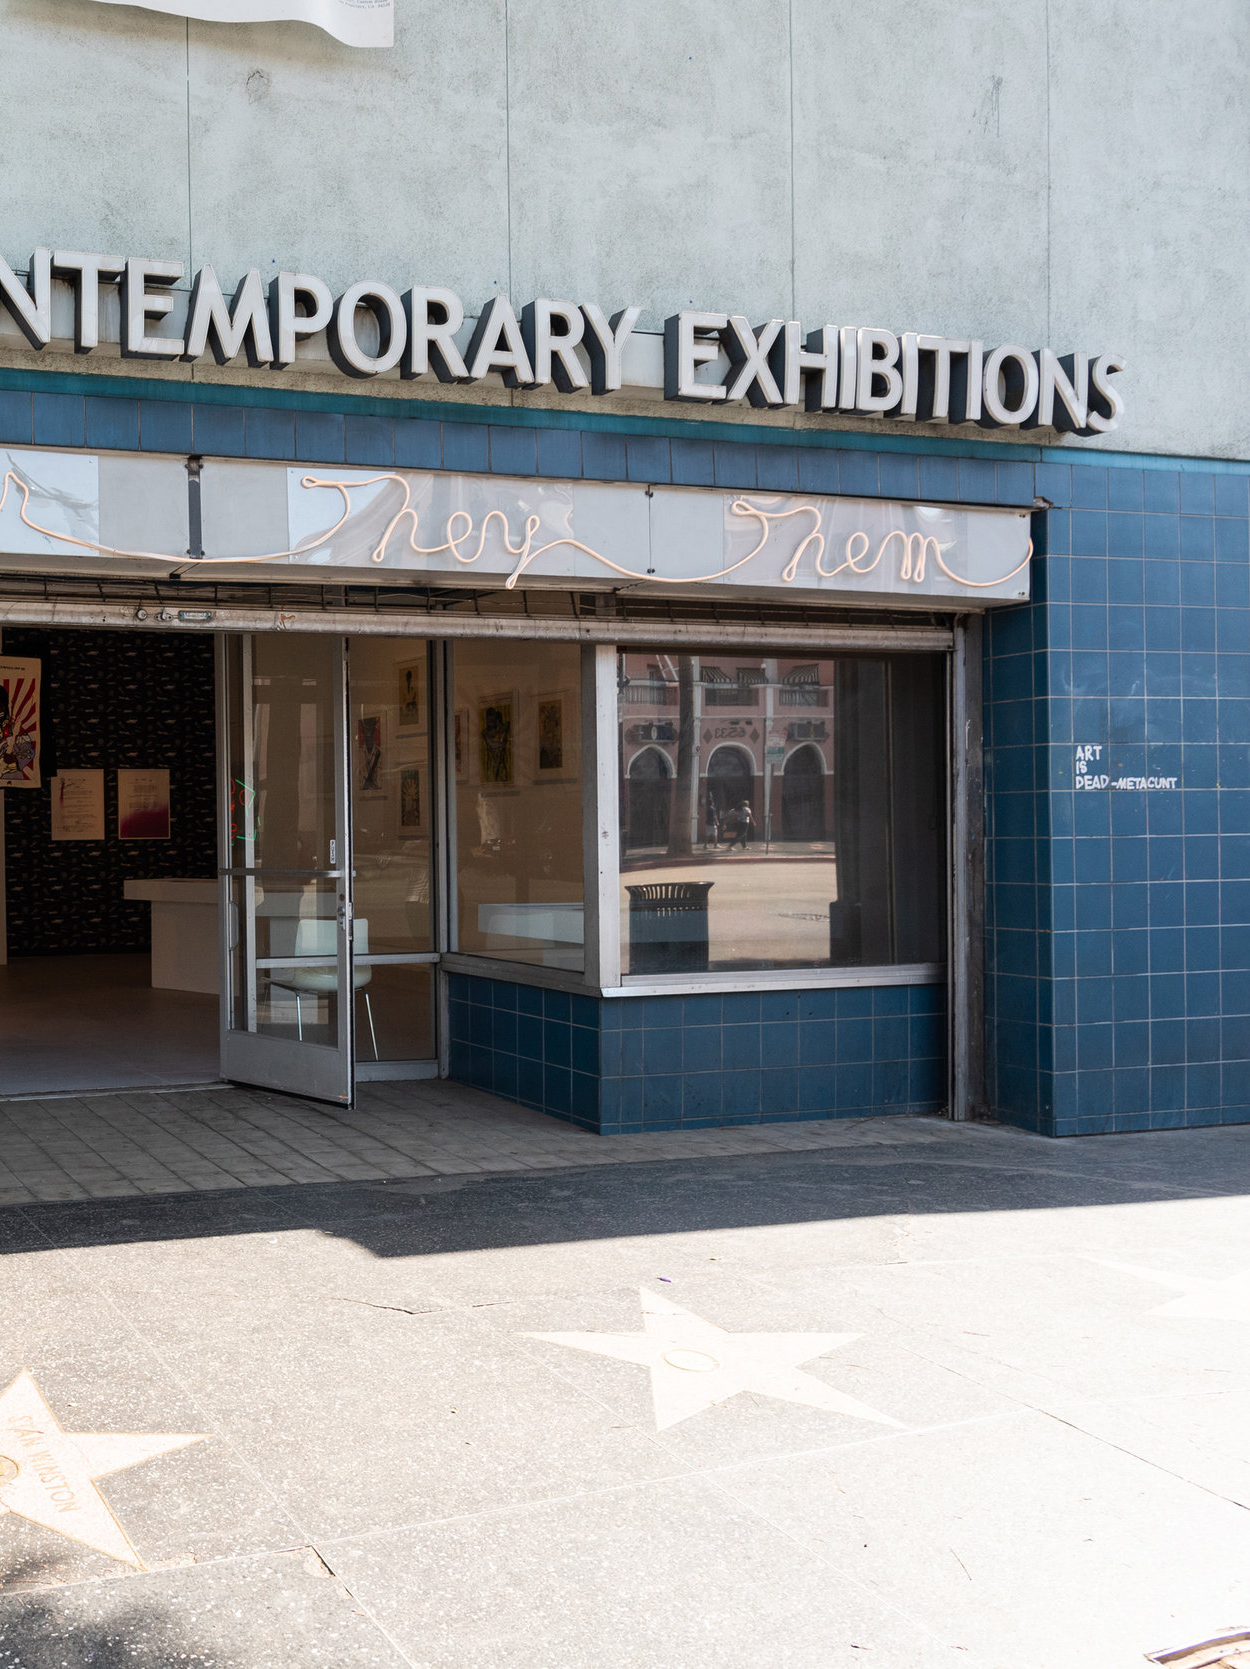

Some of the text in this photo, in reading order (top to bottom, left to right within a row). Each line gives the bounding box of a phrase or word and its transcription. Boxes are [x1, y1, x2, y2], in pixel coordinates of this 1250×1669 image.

[664, 310, 1126, 436] EXHIBITIONS
[300, 472, 550, 590] They
[730, 498, 945, 584] Them
[1075, 745, 1103, 761] ART
[1075, 761, 1088, 774] IS
[28, 1450, 83, 1513] WINSTON
